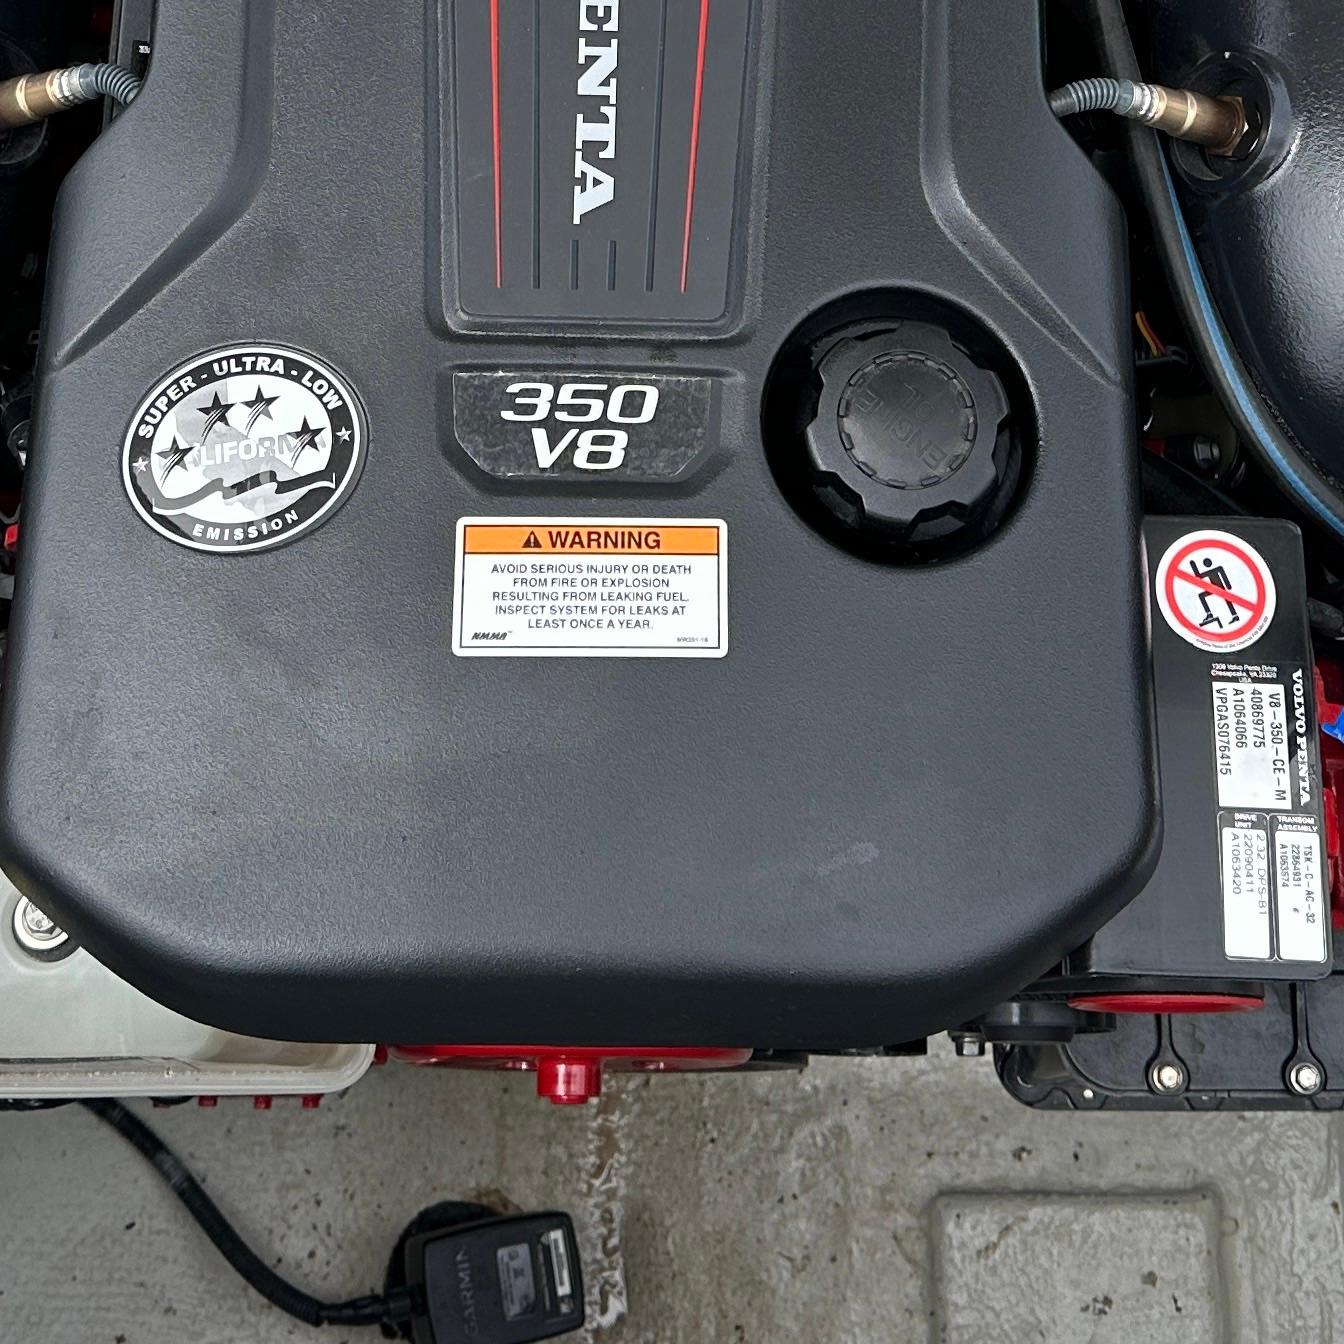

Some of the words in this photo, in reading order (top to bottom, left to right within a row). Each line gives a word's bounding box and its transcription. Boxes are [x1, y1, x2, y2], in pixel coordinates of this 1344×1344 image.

[138, 376, 197, 439] SUPER
[213, 356, 285, 376] ULTRA
[301, 370, 344, 411] LOW
[500, 382, 660, 424] 350
[529, 428, 630, 470] V8
[854, 389, 948, 470] ENGINE
[193, 510, 299, 541] EMISSION
[548, 531, 661, 549] WARNING
[491, 564, 527, 574] AVOID
[531, 564, 584, 574] SERIOUS
[587, 564, 627, 574] INJURY
[632, 564, 650, 574] OR
[653, 564, 691, 574] DEATH
[513, 578, 547, 588] FROM
[551, 578, 577, 588] FIRE
[581, 578, 598, 588] OR
[602, 578, 670, 588] EXPLOSION
[493, 591, 559, 602] RESULTING
[563, 591, 597, 602] FROM
[601, 591, 653, 602] LEAKING
[495, 605, 545, 615] INSPECT
[550, 605, 598, 615] SYSTEM
[602, 605, 625, 615] FOR
[629, 605, 668, 615] LEAKS
[672, 605, 686, 615] AT
[528, 619, 566, 629] LEAST
[570, 619, 603, 629] ONCE
[607, 619, 615, 629] A
[618, 619, 653, 629] YEAR.
[1233, 688, 1247, 749] A1064066
[1251, 688, 1265, 748] 40869775
[1292, 668, 1306, 734] VOLVO
[1216, 688, 1232, 775] VPGAS076415
[1297, 736, 1311, 806] PENTA
[1234, 813, 1257, 821] DRIVE
[1277, 824, 1318, 832] ASSEMBLY
[1231, 832, 1242, 894] A1063420
[1243, 834, 1254, 893] 22090411
[456, 1246, 478, 1336] GARMIN
